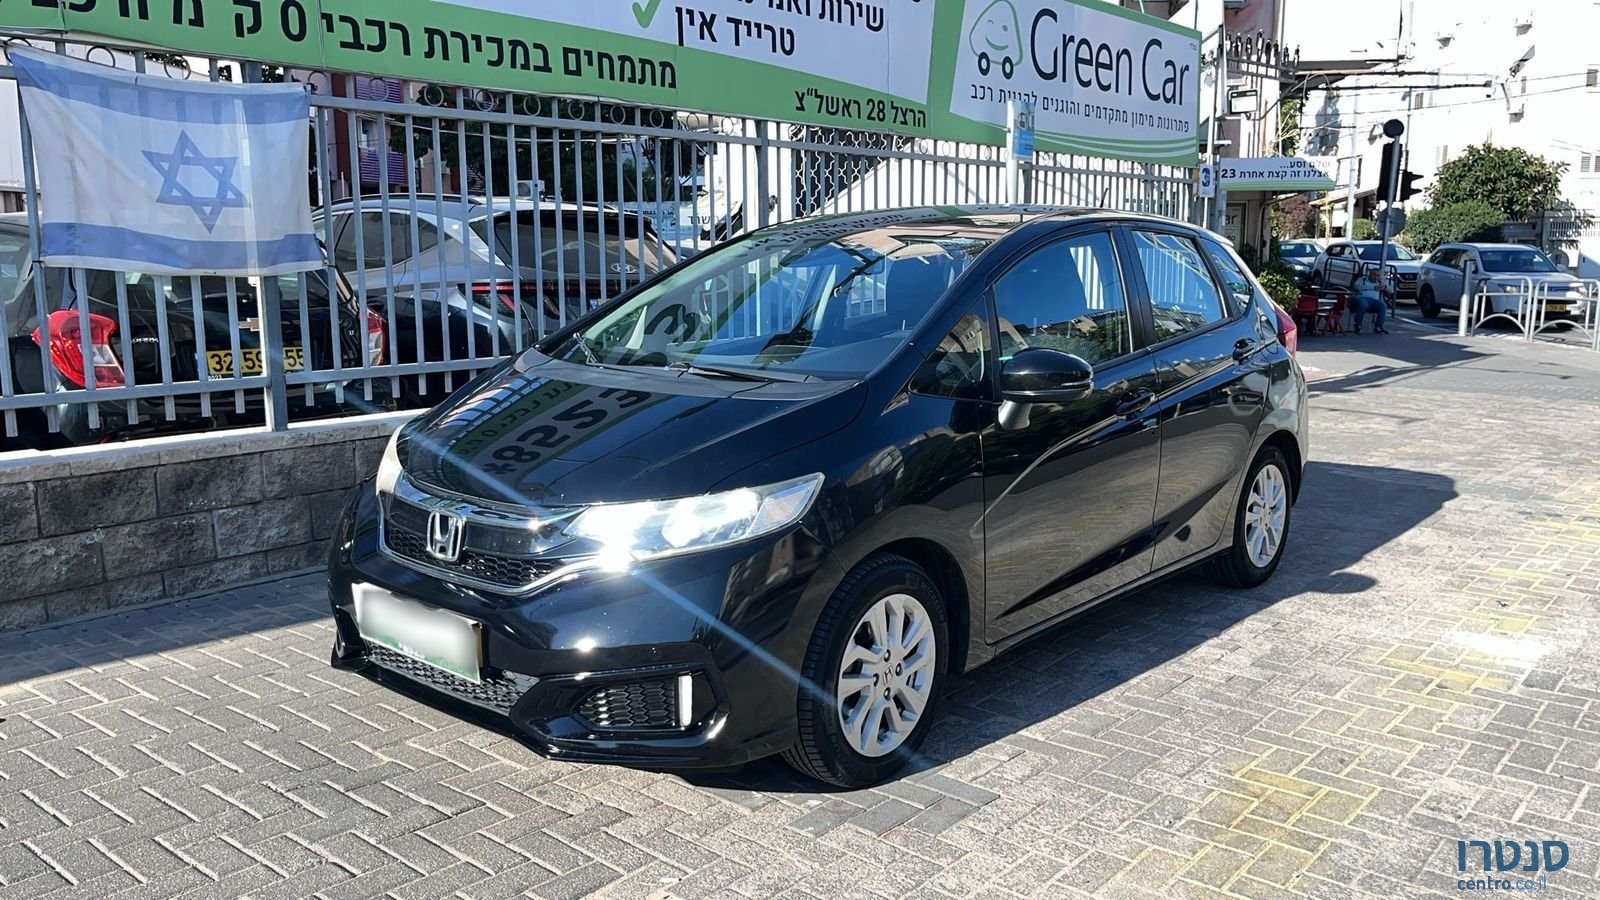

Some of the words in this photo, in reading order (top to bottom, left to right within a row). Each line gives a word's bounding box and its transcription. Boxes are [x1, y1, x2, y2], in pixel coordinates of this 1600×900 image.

[675, 7, 718, 47] אין
[819, 0, 884, 32] שירות
[321, 12, 411, 57] רכבי
[726, 16, 795, 56] טרייד
[423, 26, 553, 74] במכירת
[1031, 8, 1133, 96] Green
[1142, 38, 1190, 106] Car
[562, 46, 677, 89] מתמחים
[795, 87, 862, 119] ראשל"צ
[971, 84, 993, 102] רכב
[1042, 96, 1080, 116] והוגנים
[866, 97, 886, 123] 28
[890, 99, 926, 129] הרצל
[1084, 103, 1129, 124] מתקדמים
[1131, 111, 1154, 129] מימון
[1156, 115, 1190, 133] פתרונות
[1220, 168, 1236, 178] 23
[1239, 170, 1264, 178] אחרת
[1267, 170, 1287, 180] קצת
[1290, 170, 1302, 178] זה
